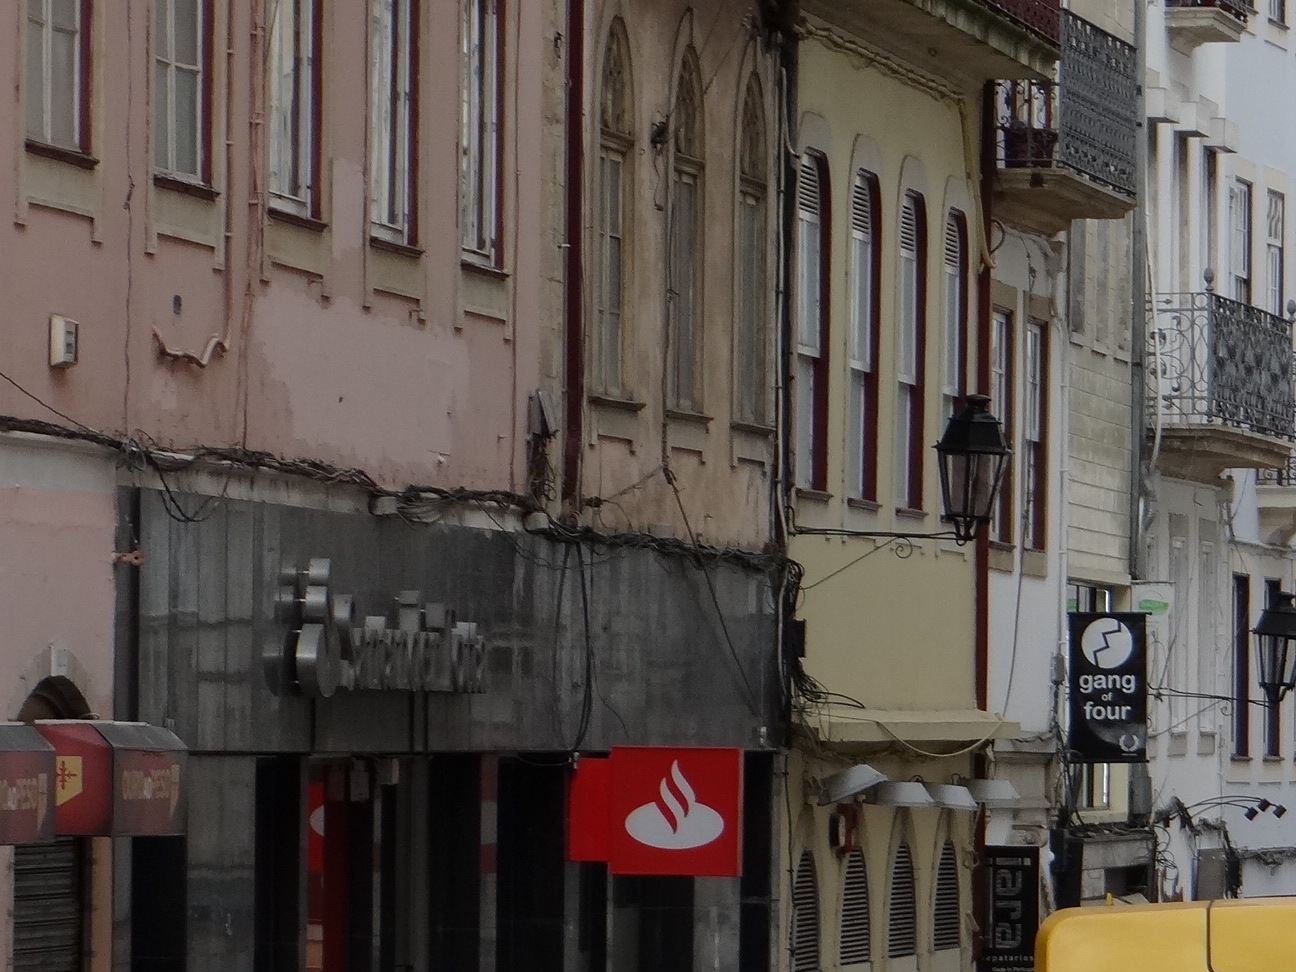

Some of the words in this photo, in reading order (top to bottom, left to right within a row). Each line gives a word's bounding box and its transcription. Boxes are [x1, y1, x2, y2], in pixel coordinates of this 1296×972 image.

[1079, 674, 1136, 694] gang
[1102, 692, 1113, 701] of
[1083, 701, 1131, 720] four
